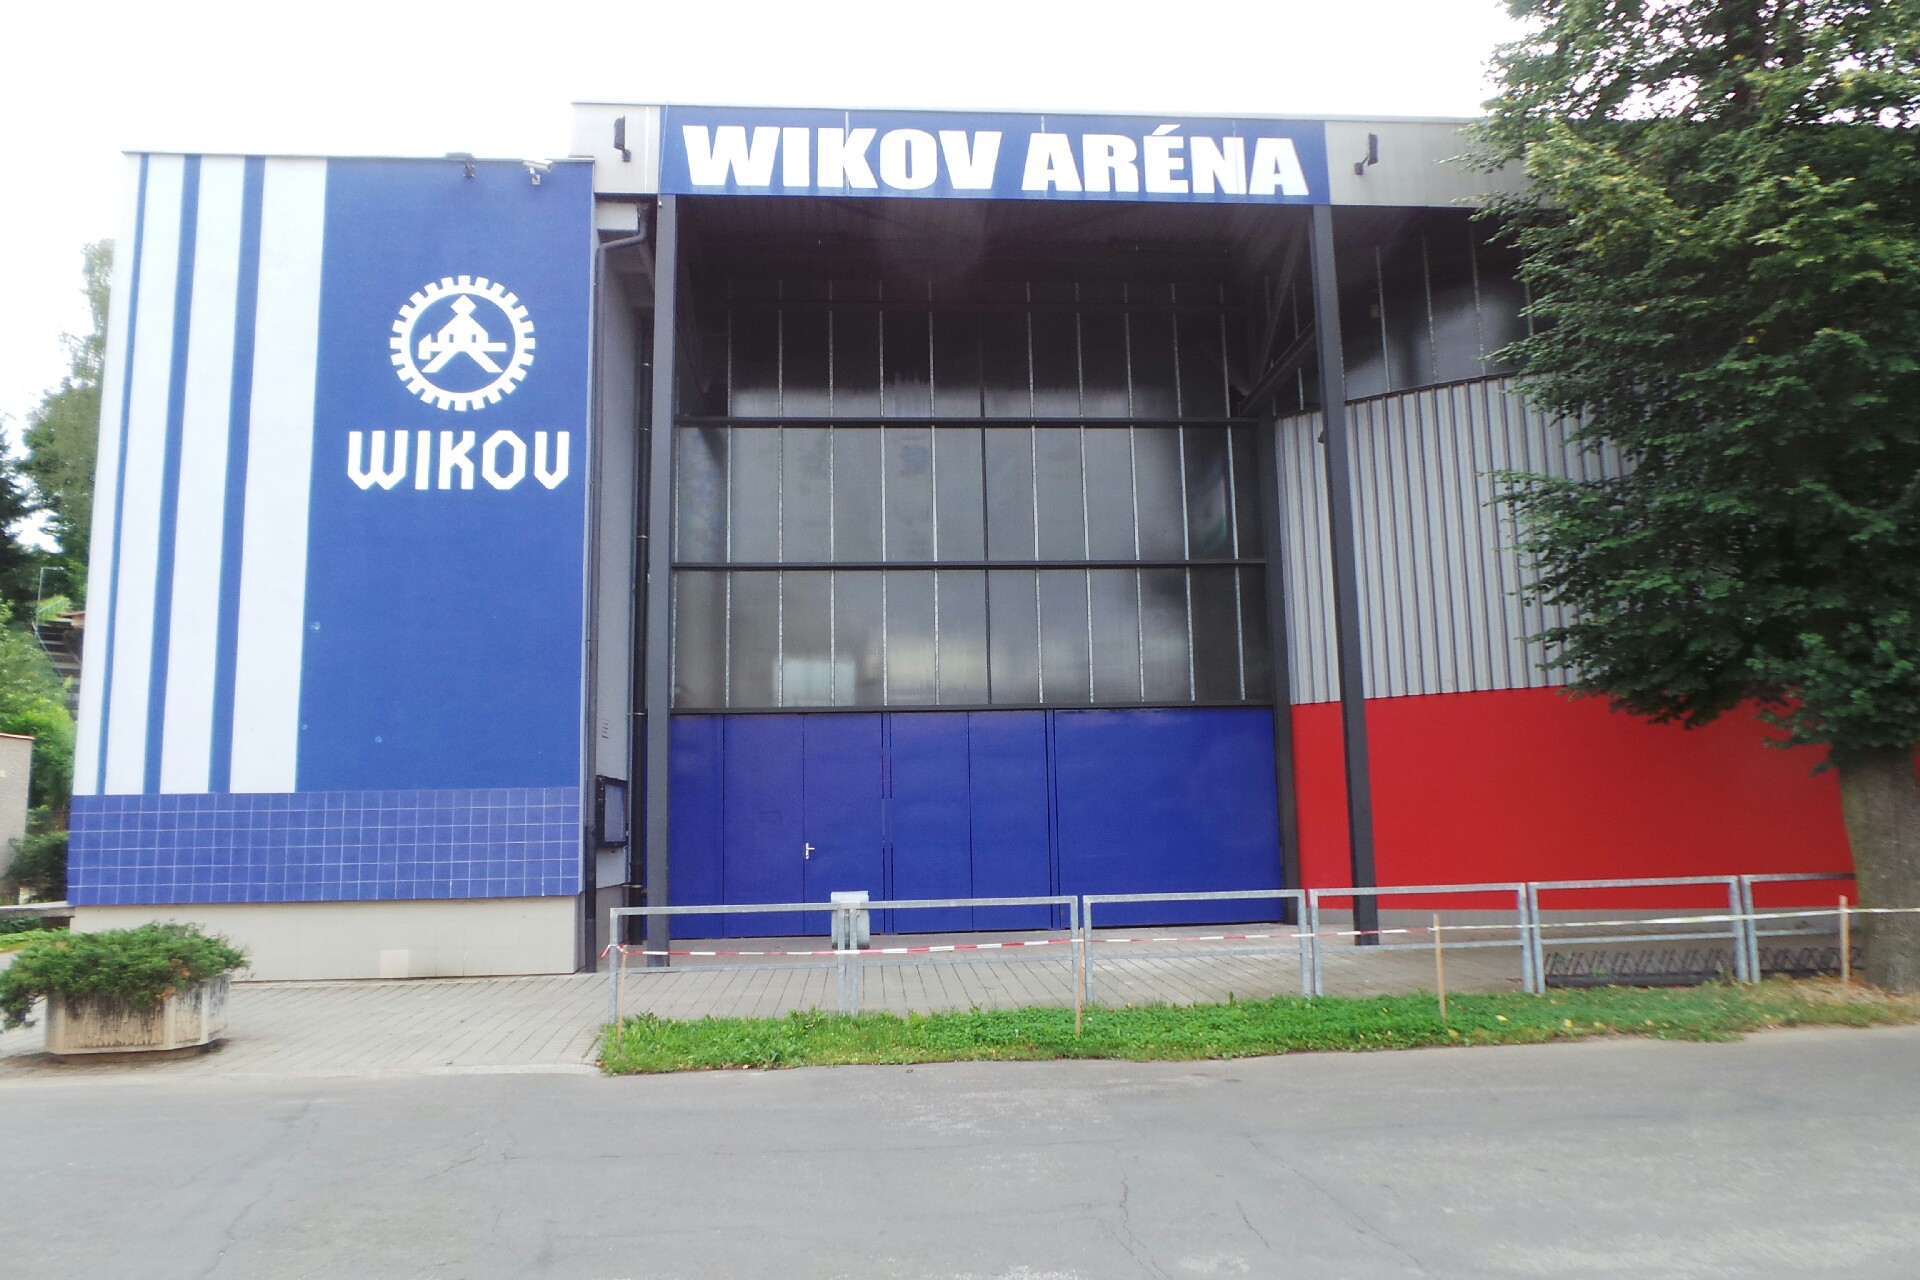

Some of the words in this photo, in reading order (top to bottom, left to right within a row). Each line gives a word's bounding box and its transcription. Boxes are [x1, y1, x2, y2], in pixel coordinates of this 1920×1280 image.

[681, 124, 1003, 192] WIKOV
[1021, 123, 1310, 196] ARÉNA
[346, 429, 571, 492] WIKOV
